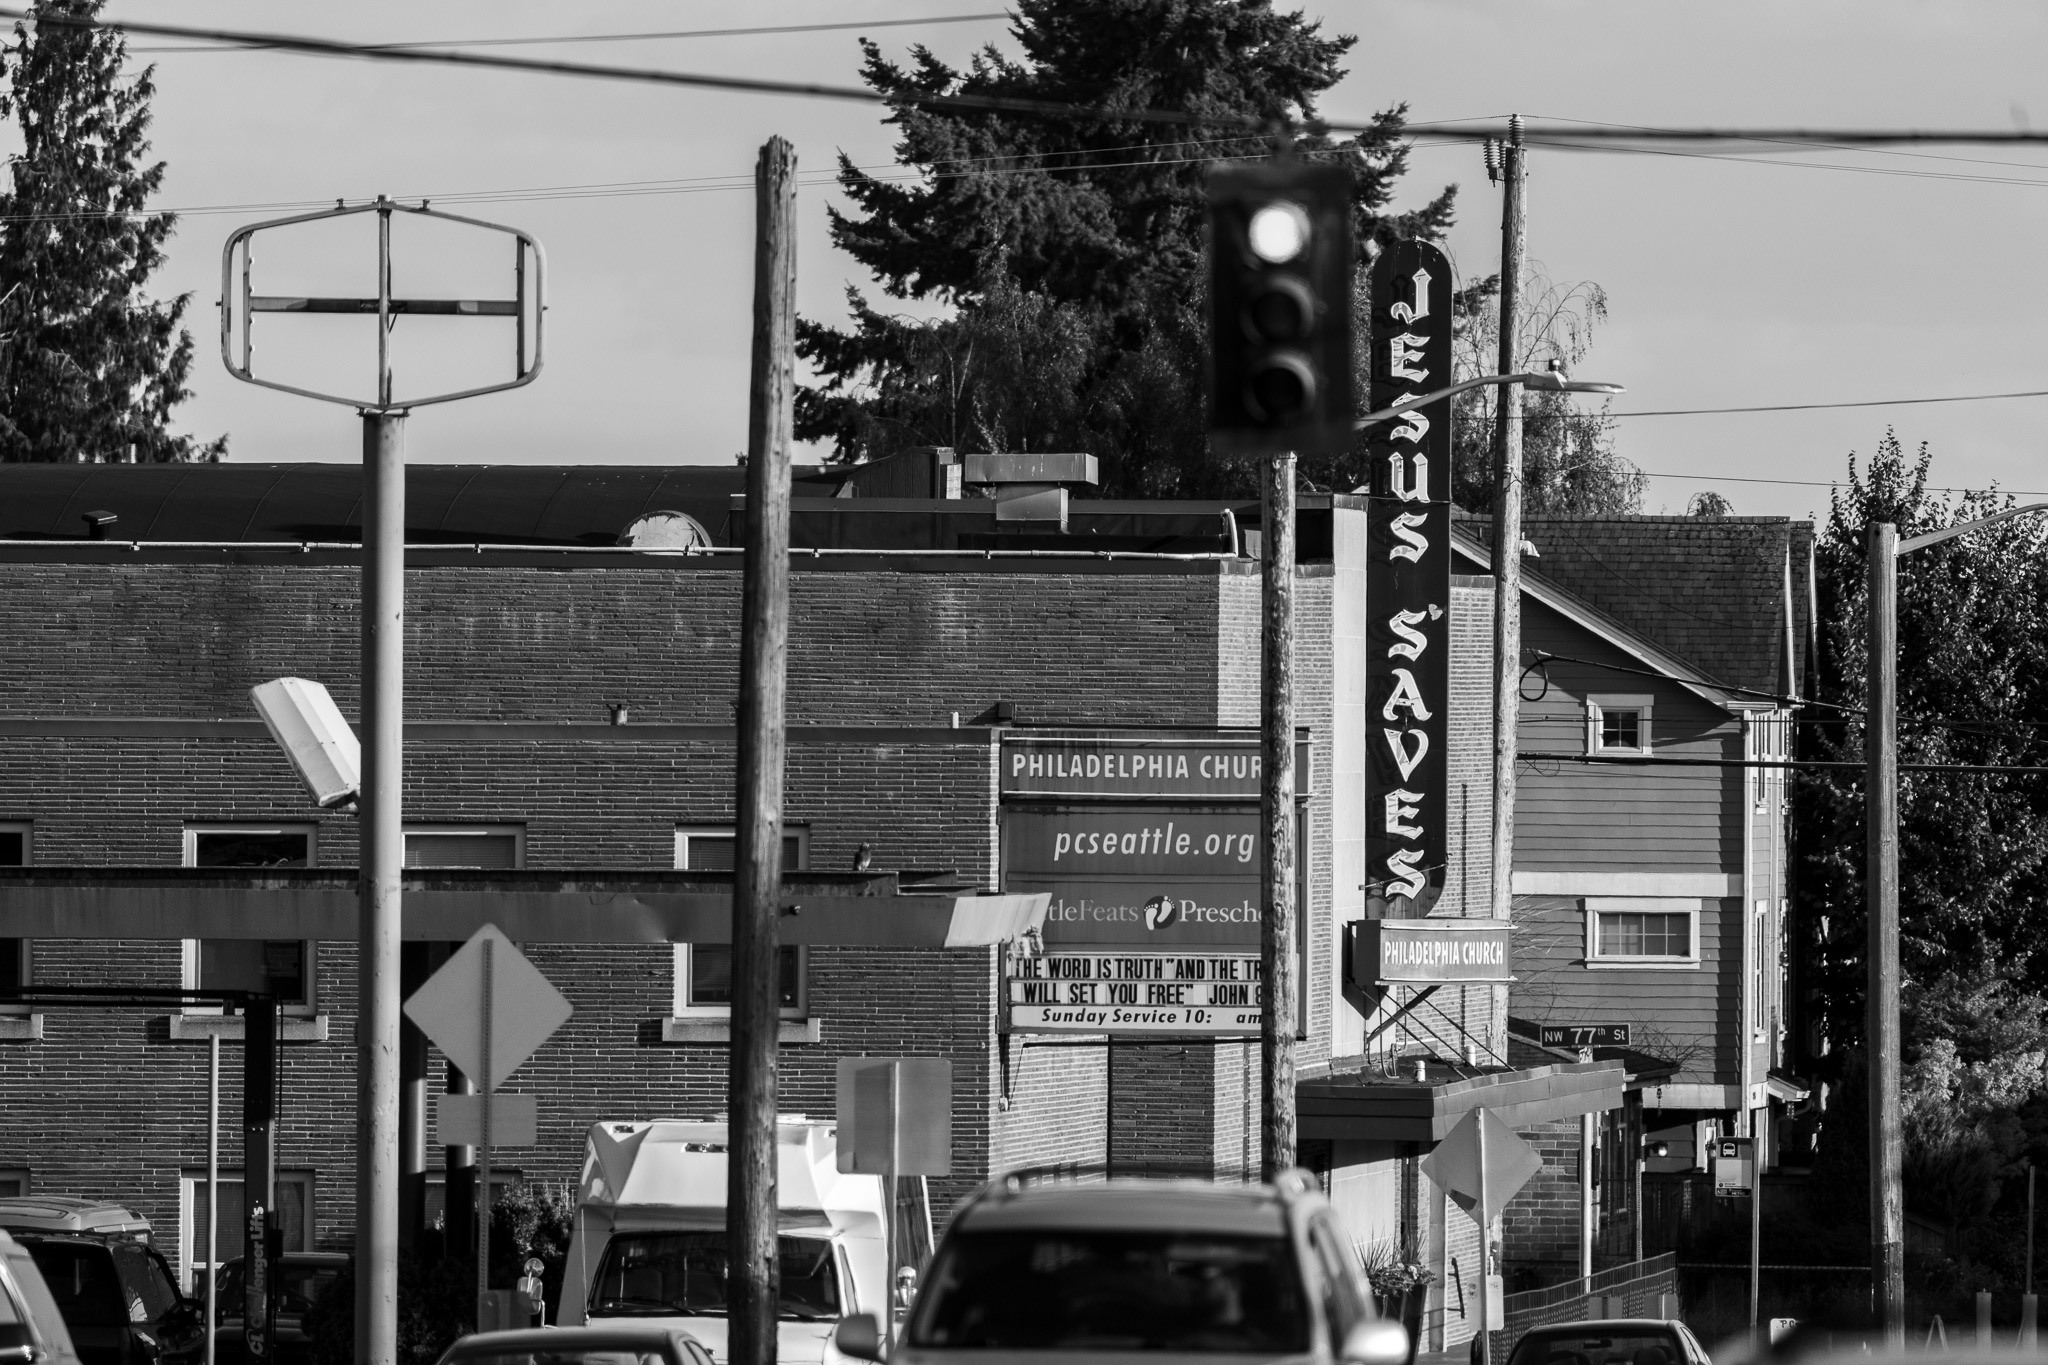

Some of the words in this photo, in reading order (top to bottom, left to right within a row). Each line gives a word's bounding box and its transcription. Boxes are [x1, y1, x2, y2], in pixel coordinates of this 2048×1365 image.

[1389, 268, 1430, 566] JESUS
[1012, 753, 1189, 778] PHILADELPHIA
[1198, 755, 1261, 778] CHUR
[1382, 608, 1432, 901] SAVES
[1053, 822, 1254, 862] pcseattle.org
[1048, 899, 1138, 922] tleFeats
[1384, 941, 1460, 965] PHILADELPHIA
[1462, 941, 1504, 965] CHURCH
[1048, 958, 1091, 979] WORD
[1097, 959, 1111, 979] IS
[1114, 959, 1162, 980] TRUTH
[1208, 960, 1238, 980] THE
[1243, 960, 1261, 980] TR
[1023, 983, 1061, 1003] WILL
[1069, 983, 1098, 1003] SET
[1107, 984, 1138, 1004] YOU
[1208, 985, 1247, 1005] JOHN
[1041, 1008, 1107, 1025] Sunday
[1112, 1008, 1177, 1023] Service
[1185, 1010, 1212, 1024] 10:
[1545, 1030, 1563, 1042] NW
[1570, 1027, 1606, 1044] 77th
[1613, 1029, 1626, 1041] St
[249, 1206, 265, 1240] Lifts
